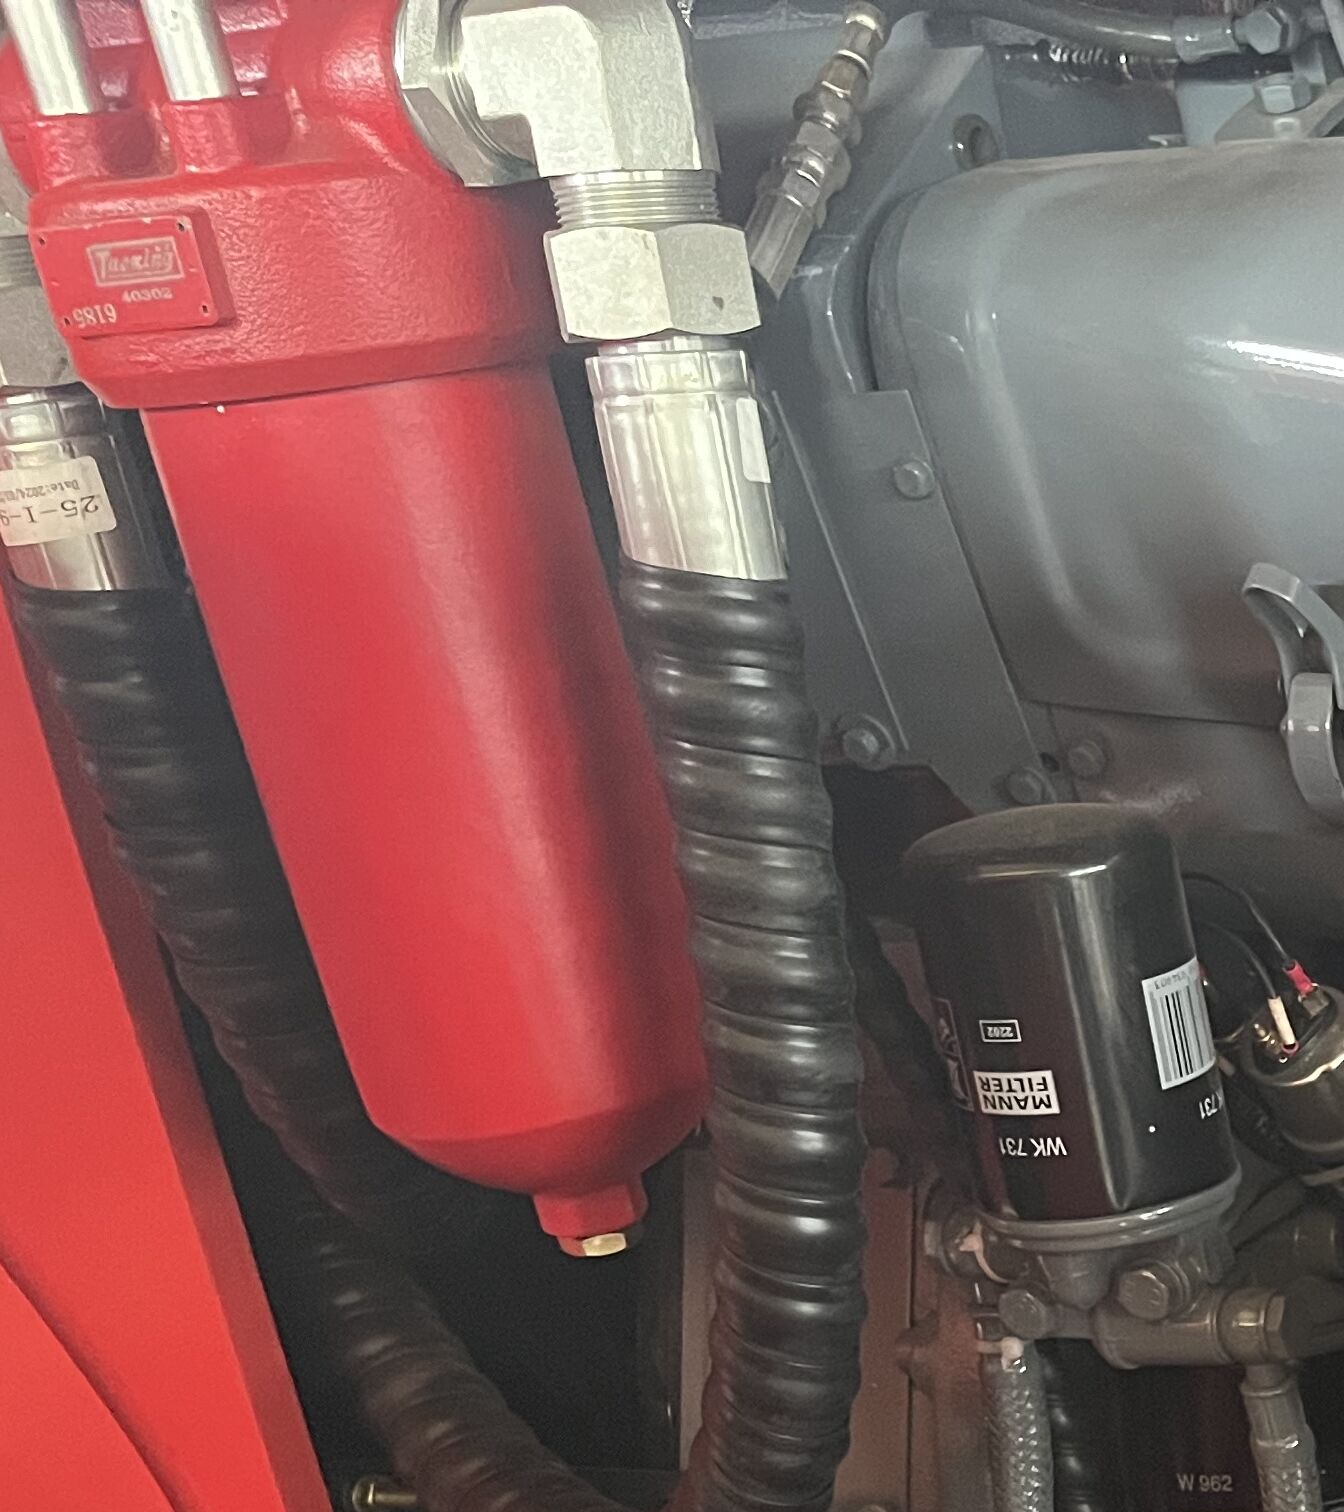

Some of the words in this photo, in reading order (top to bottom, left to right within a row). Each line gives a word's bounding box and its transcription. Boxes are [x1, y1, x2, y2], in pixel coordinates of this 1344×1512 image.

[978, 1076, 1049, 1093] FILTER
[982, 1094, 1053, 1111] MANN
[999, 1137, 1028, 1157] 731
[1030, 1136, 1068, 1157] WK
[1176, 1472, 1194, 1492] W
[1199, 1474, 1233, 1492] 962
